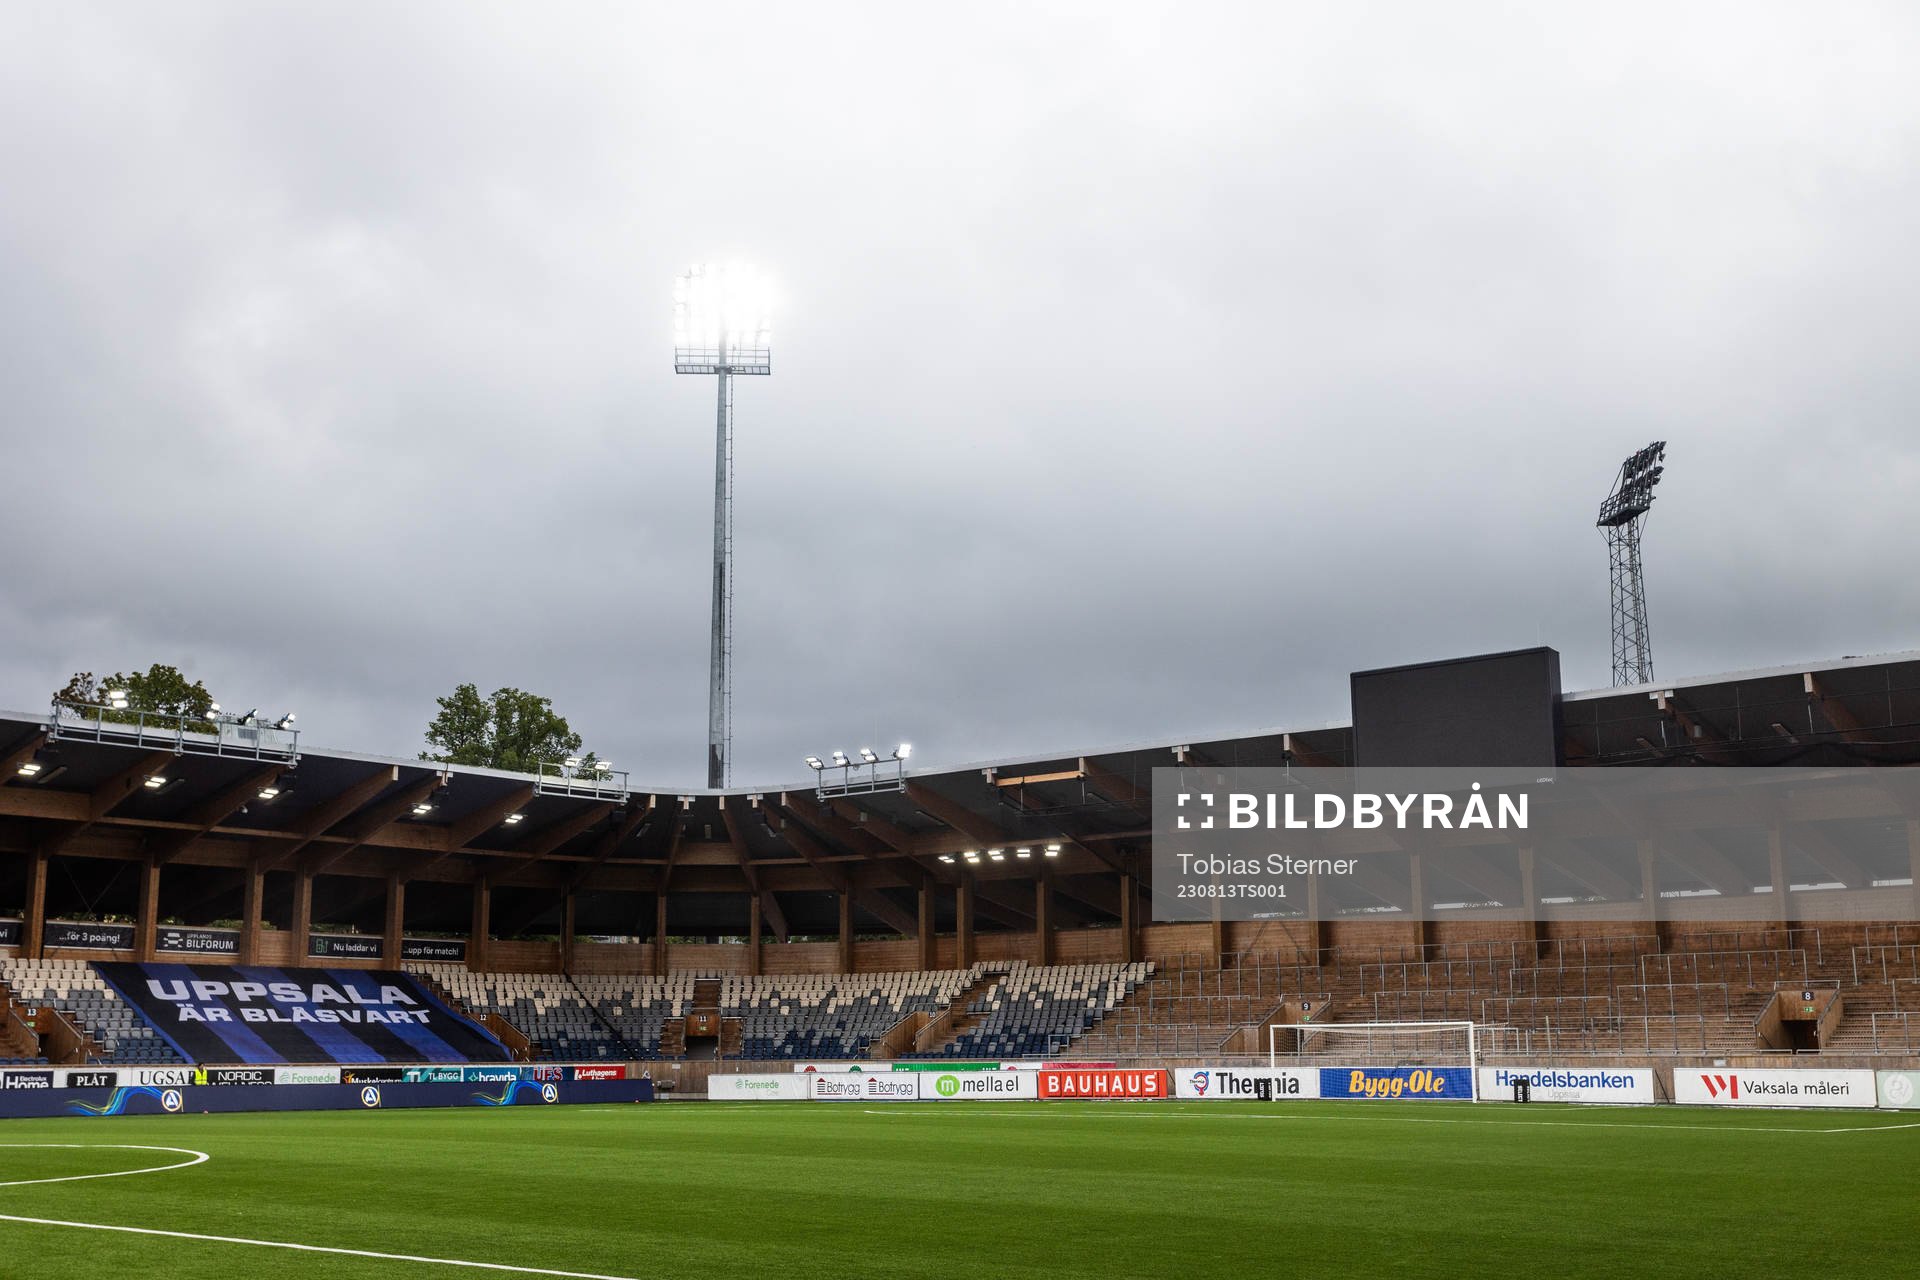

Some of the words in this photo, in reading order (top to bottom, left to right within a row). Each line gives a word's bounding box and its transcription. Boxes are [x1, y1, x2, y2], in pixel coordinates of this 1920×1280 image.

[82, 932, 88, 941] 3
[186, 939, 234, 950] BILFORUM
[333, 943, 344, 952] Nu
[346, 943, 368, 952] laddar
[370, 944, 377, 953] vi
[423, 946, 433, 955] för
[434, 947, 459, 956] match!
[146, 979, 418, 1005] UPPSALA
[1804, 992, 1811, 1000] 8
[178, 1003, 232, 1022] ÄR
[239, 1005, 430, 1024] BLÅSVART
[217, 1071, 262, 1081] NORDIC
[292, 1073, 336, 1083] Forenede
[428, 1072, 438, 1080] TL
[438, 1072, 458, 1080] BYGG
[478, 1071, 516, 1082] bravida
[582, 1069, 617, 1077] Luthagens
[6, 1076, 49, 1089] Home
[76, 1074, 107, 1086] PLÅT
[744, 1080, 779, 1089] Forenede
[1047, 1074, 1157, 1093] BAUHAUS
[826, 1081, 860, 1096] Botrygg
[878, 1081, 913, 1096] Botrygg
[1743, 1080, 1798, 1095] Vaksala
[1804, 1081, 1850, 1095] måleri
